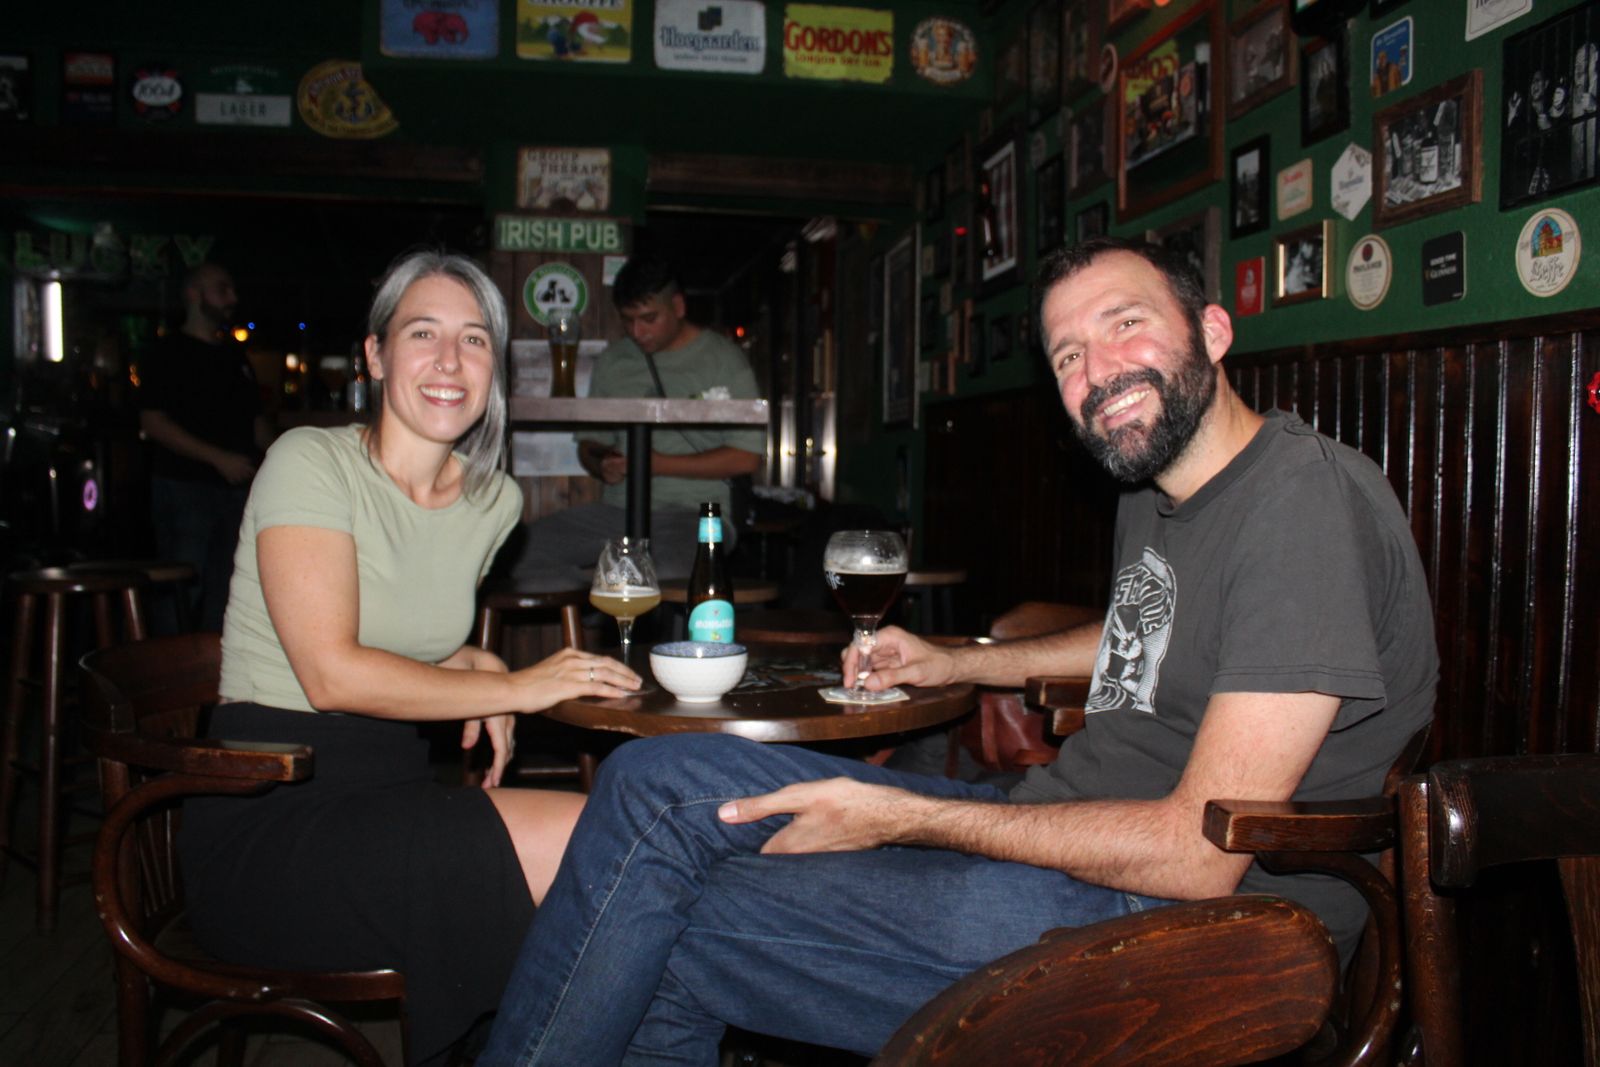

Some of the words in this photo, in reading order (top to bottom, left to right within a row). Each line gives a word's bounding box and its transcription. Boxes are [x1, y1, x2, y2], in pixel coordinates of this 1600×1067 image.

[219, 102, 267, 117] LAGER
[527, 151, 578, 162] GROUP
[540, 163, 608, 176] THERAPY
[501, 219, 562, 249] IRISH
[570, 221, 620, 250] PUB
